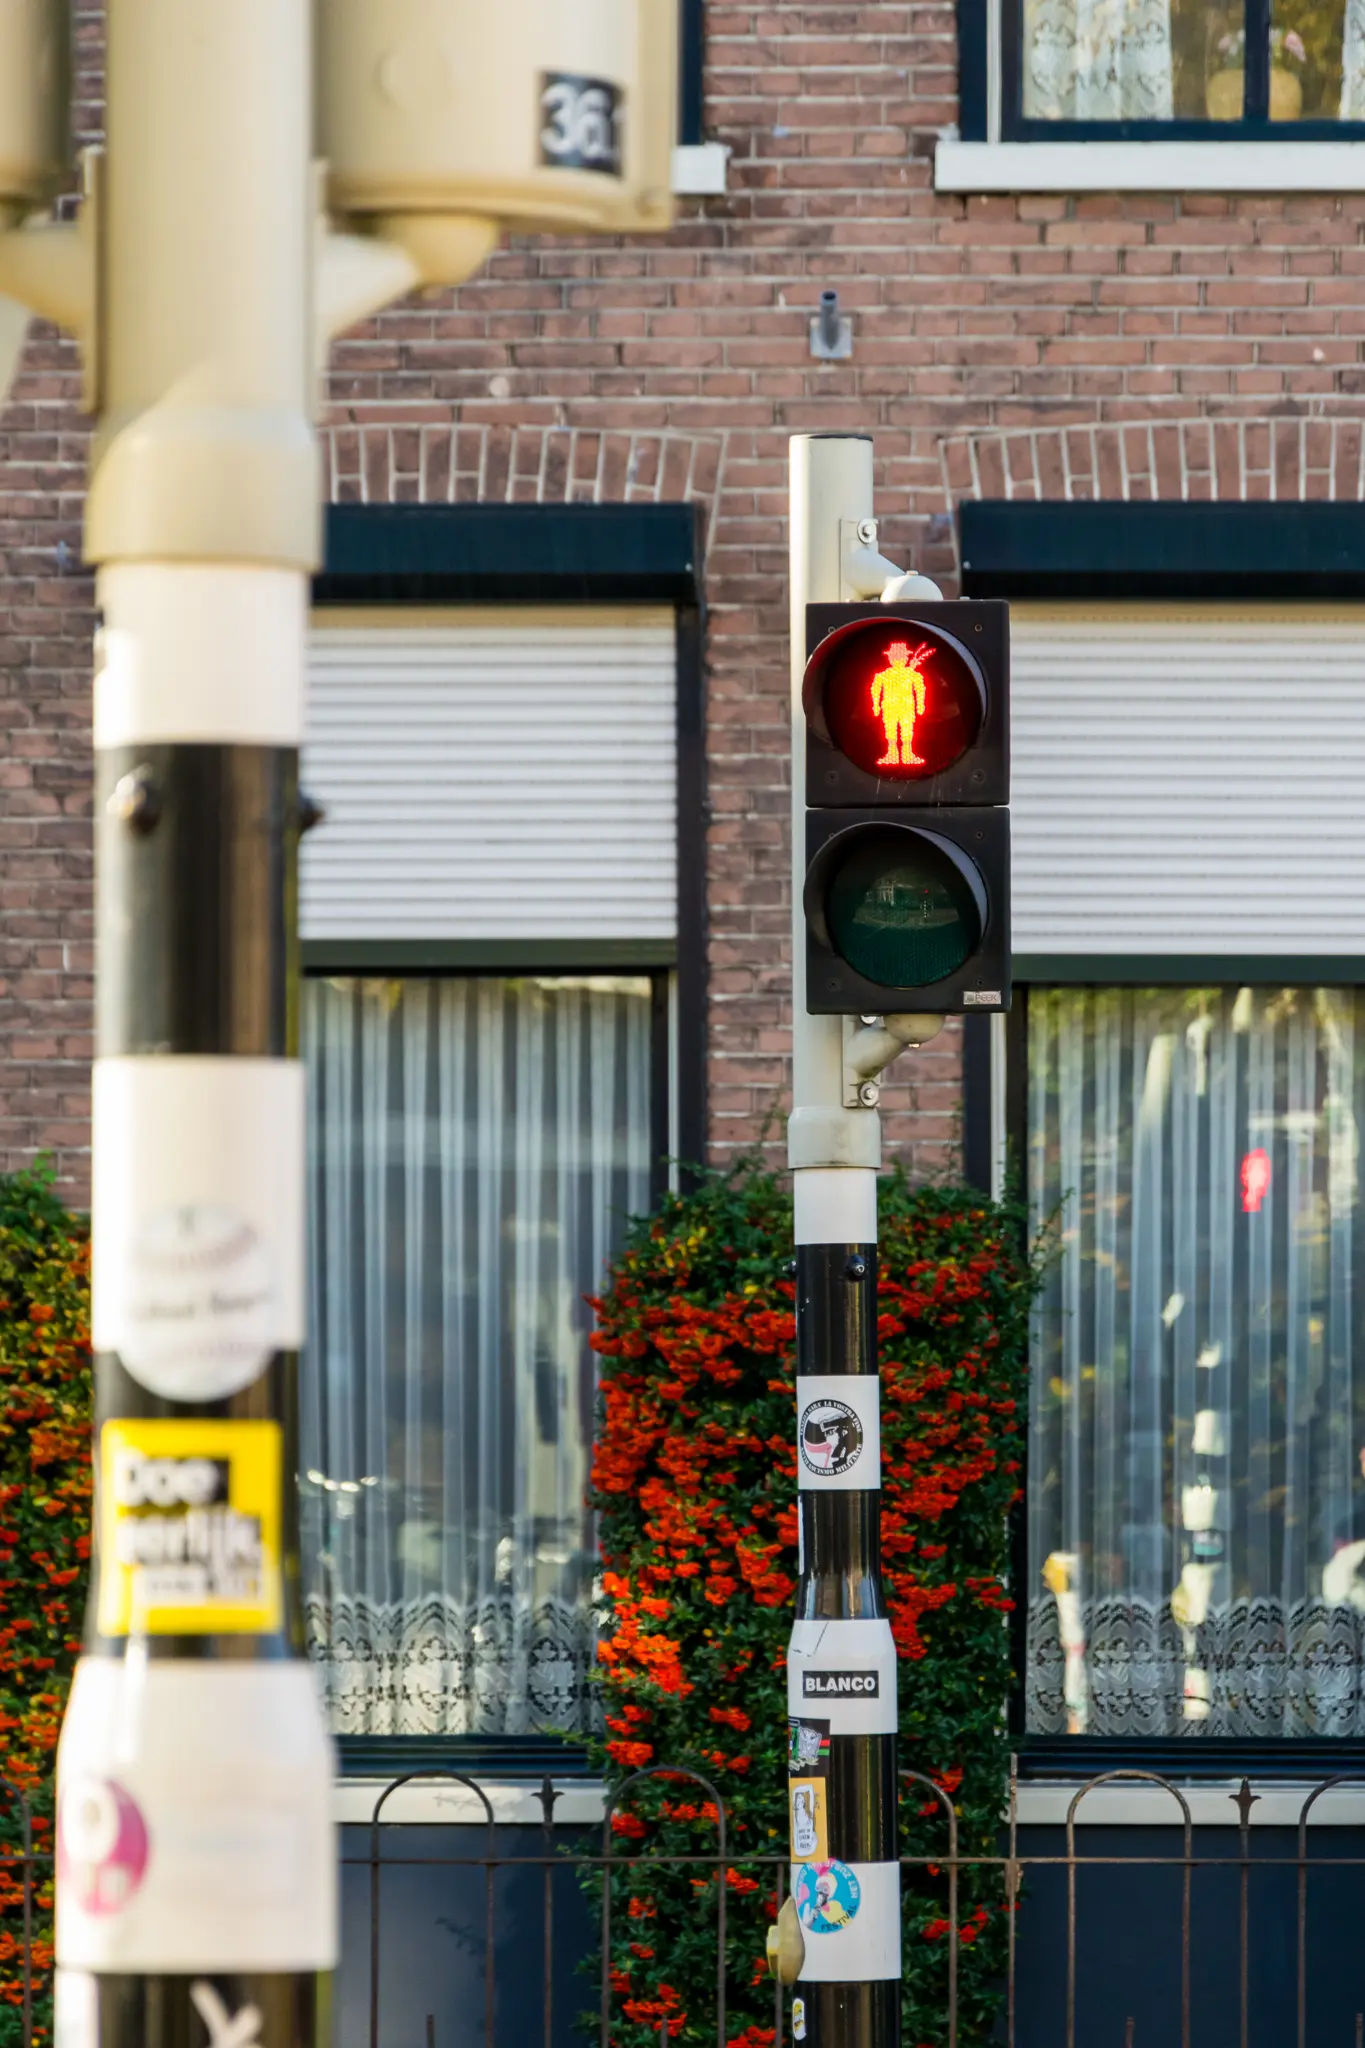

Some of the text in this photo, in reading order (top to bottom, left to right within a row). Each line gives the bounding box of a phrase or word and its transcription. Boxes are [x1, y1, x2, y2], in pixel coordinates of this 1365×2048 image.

[833, 1401, 855, 1419] VOSTRA
[835, 1444, 862, 1473] MILITANTE
[805, 1676, 876, 1692] BLANCO
[821, 1905, 857, 1931] FESTIVAL
